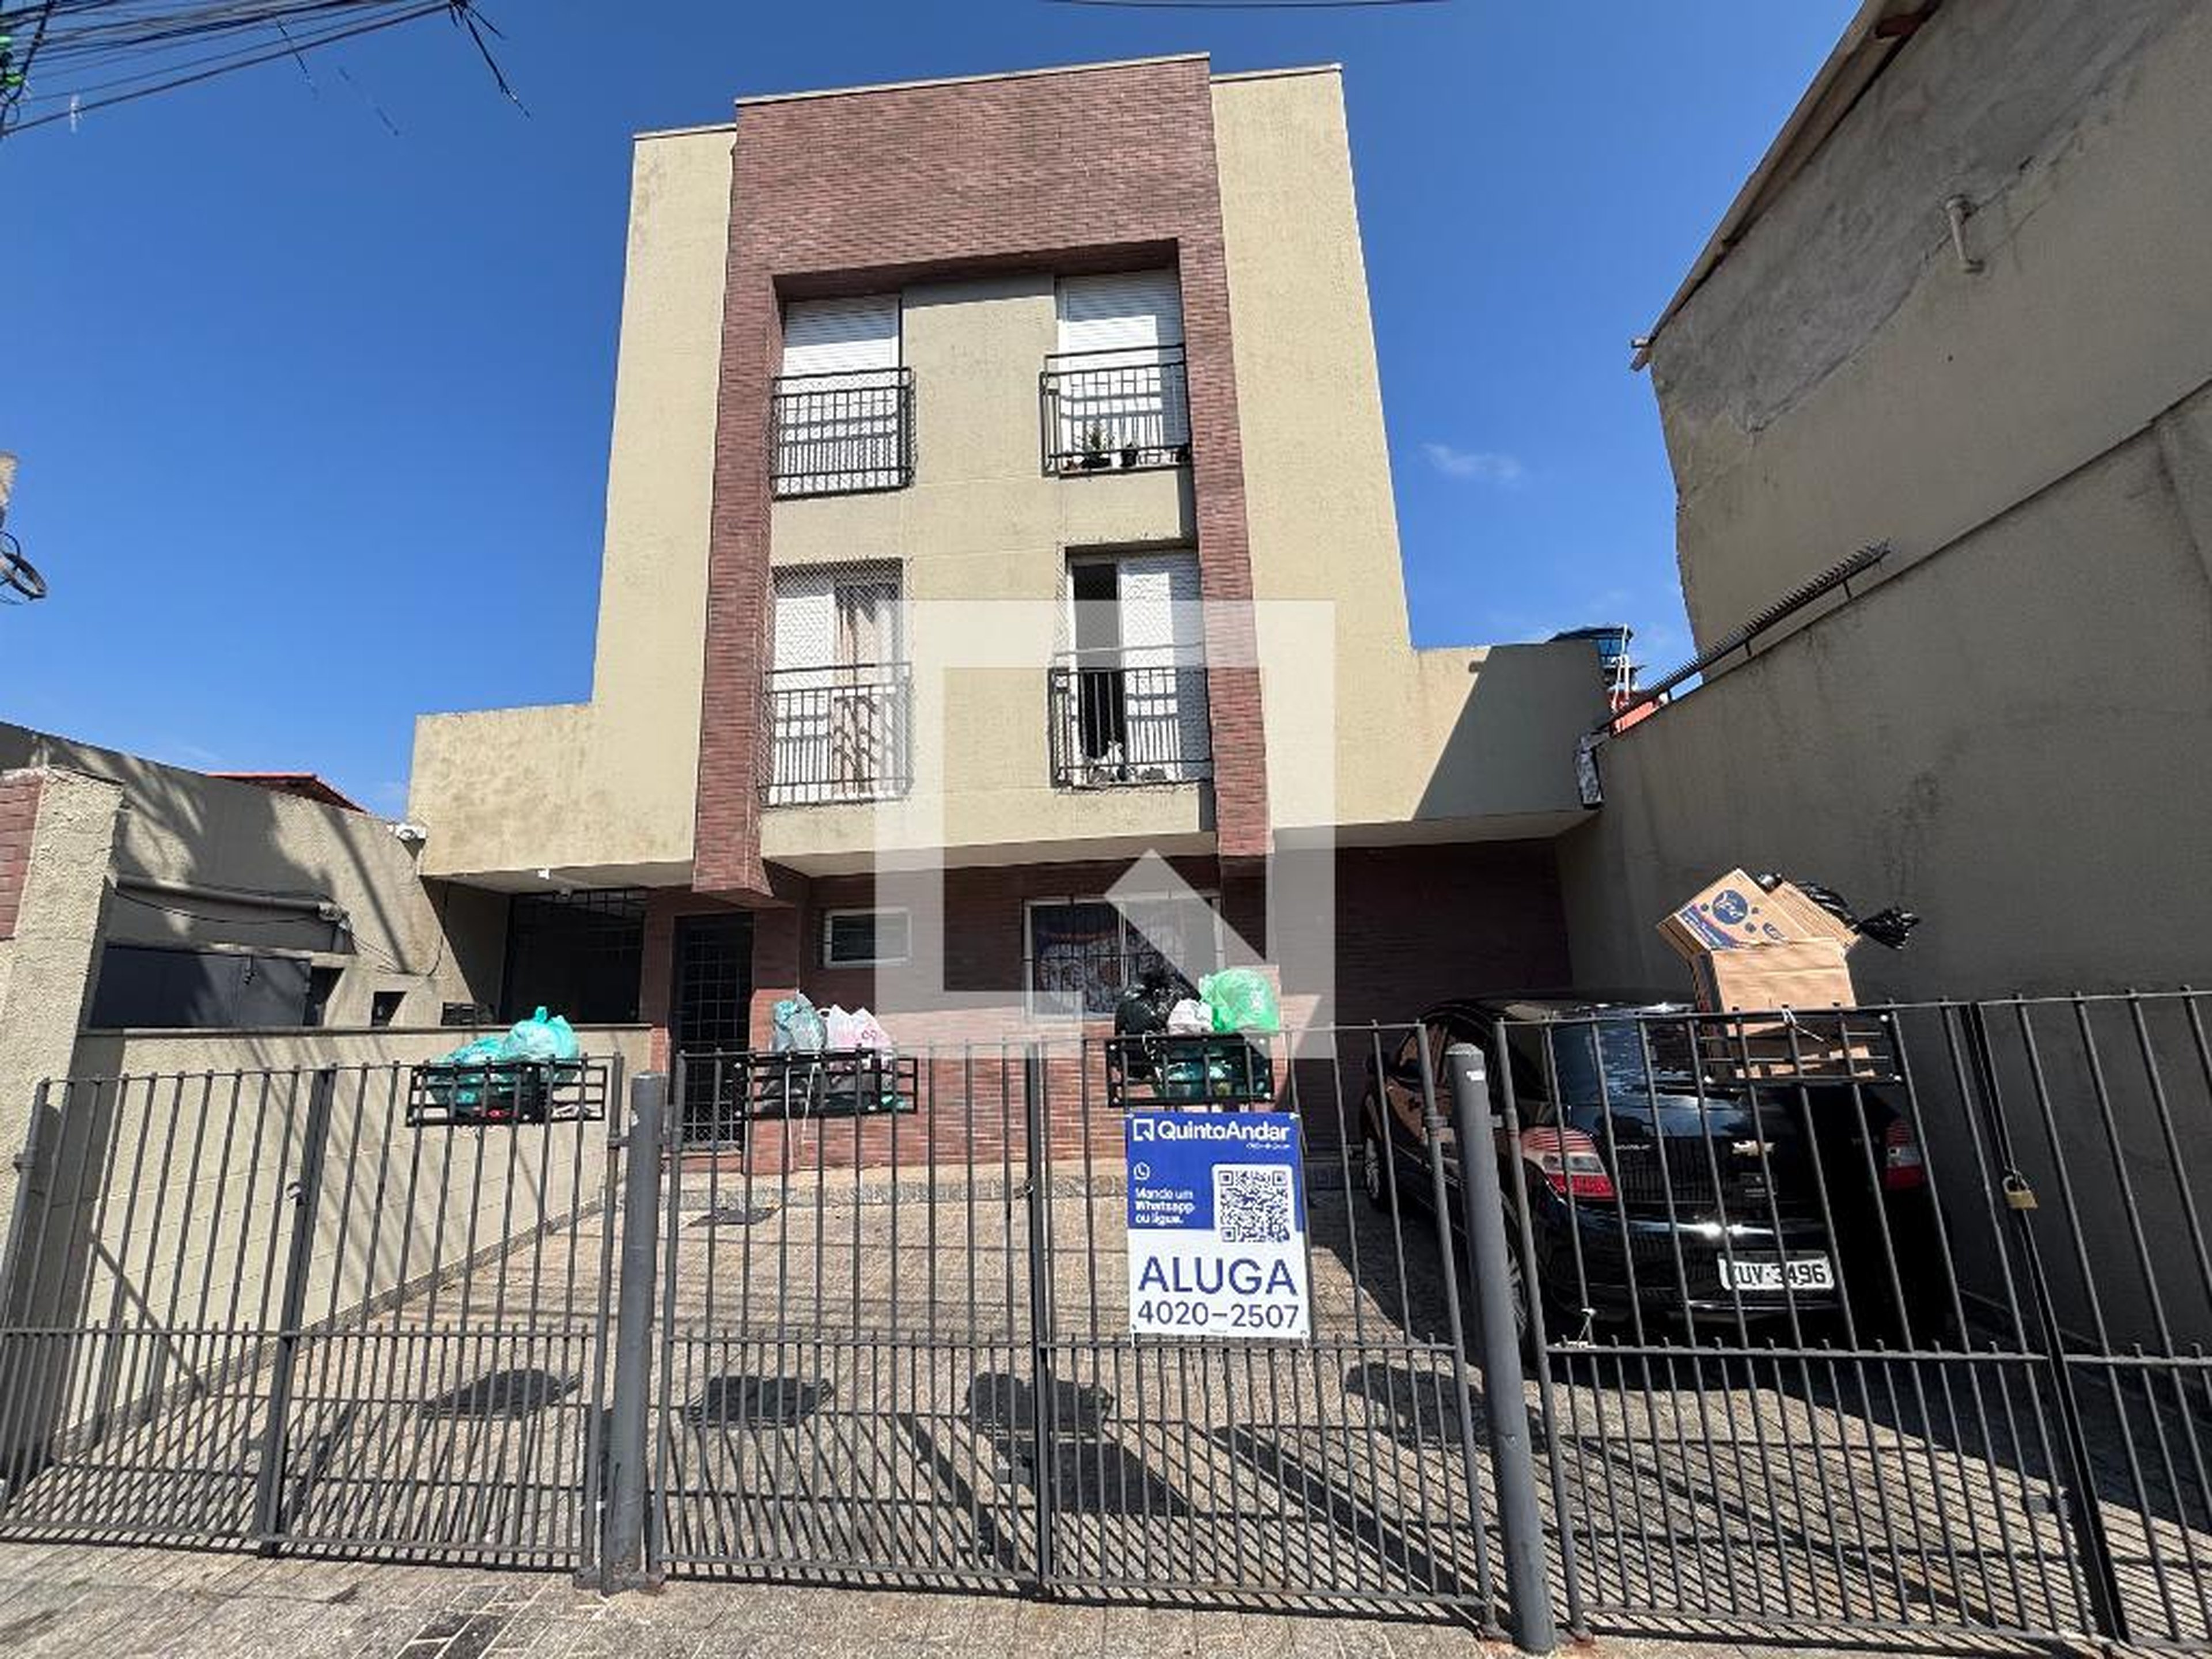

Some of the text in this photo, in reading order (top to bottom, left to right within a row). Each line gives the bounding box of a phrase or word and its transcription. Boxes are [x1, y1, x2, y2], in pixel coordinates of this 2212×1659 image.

[1158, 1120, 1290, 1141] QuintoAndar
[1138, 1256, 1298, 1296] ALUGA
[1138, 1301, 1299, 1328] 4020-2507
